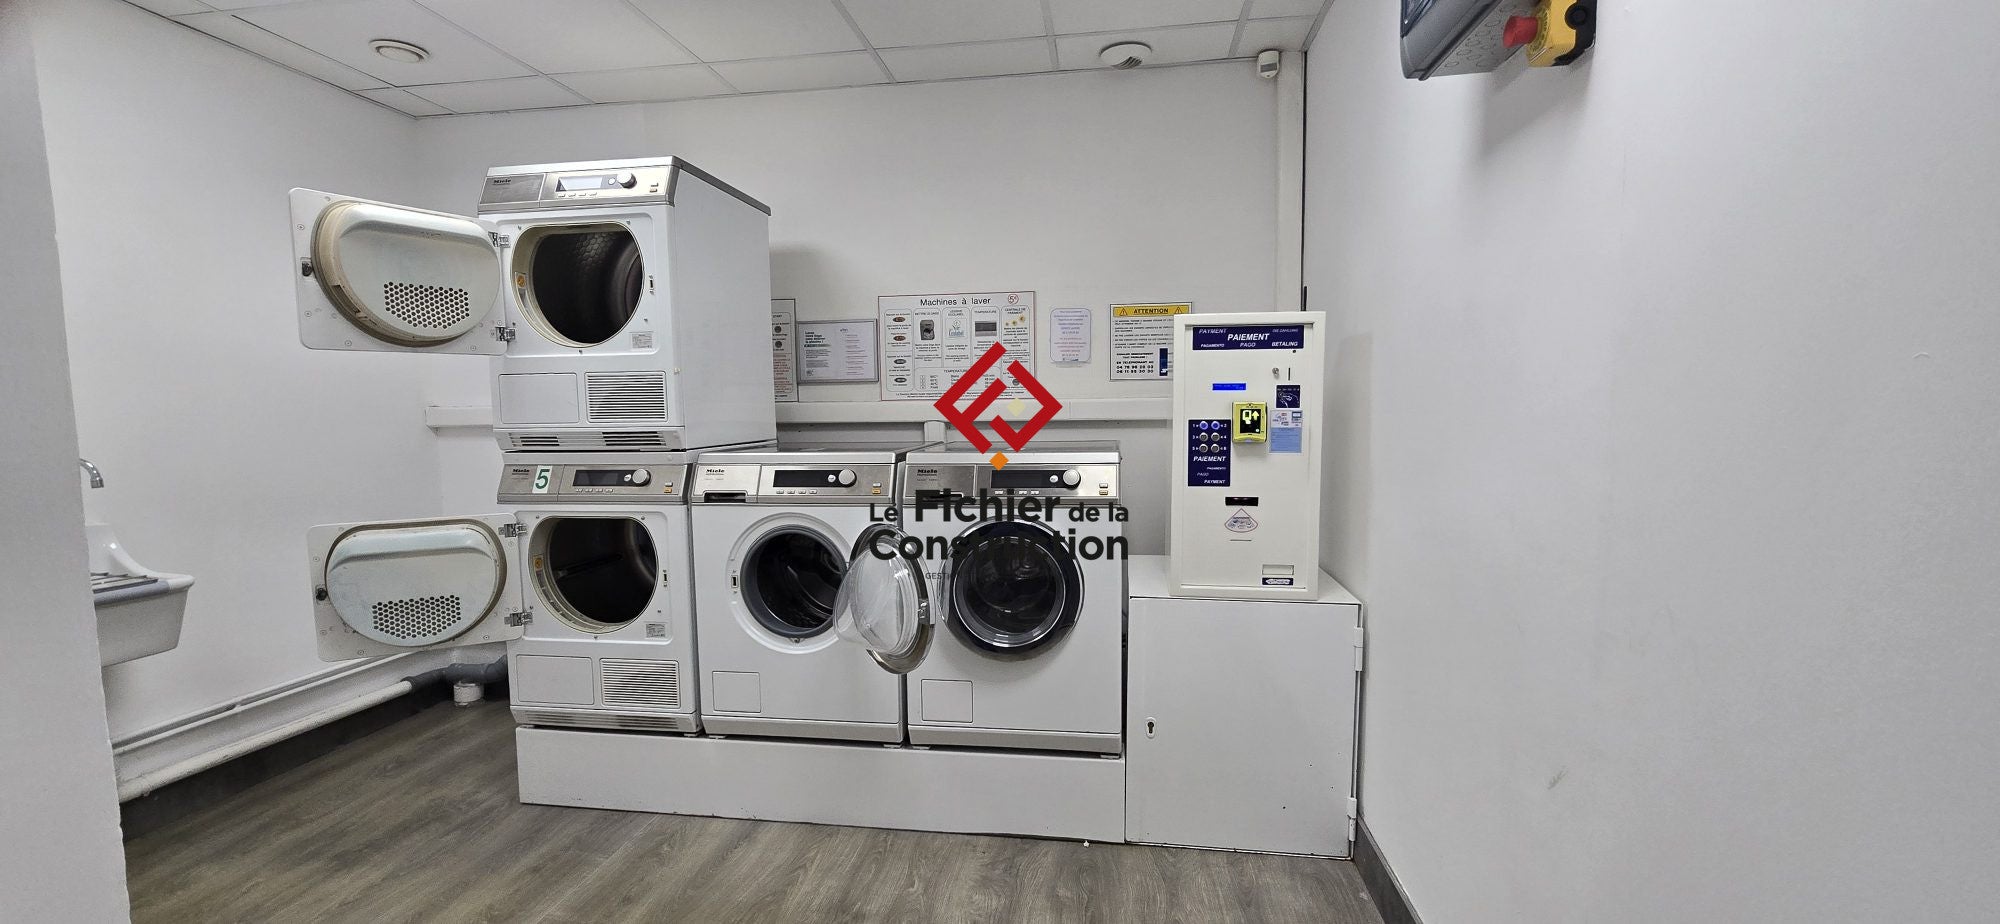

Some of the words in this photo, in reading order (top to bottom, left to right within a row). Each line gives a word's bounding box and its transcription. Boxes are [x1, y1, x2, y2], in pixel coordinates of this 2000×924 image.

[920, 298, 957, 306] Machines
[962, 297, 967, 305] à
[971, 297, 991, 305] laver
[1227, 333, 1270, 341] PAIEMENT
[535, 468, 551, 489] 5
